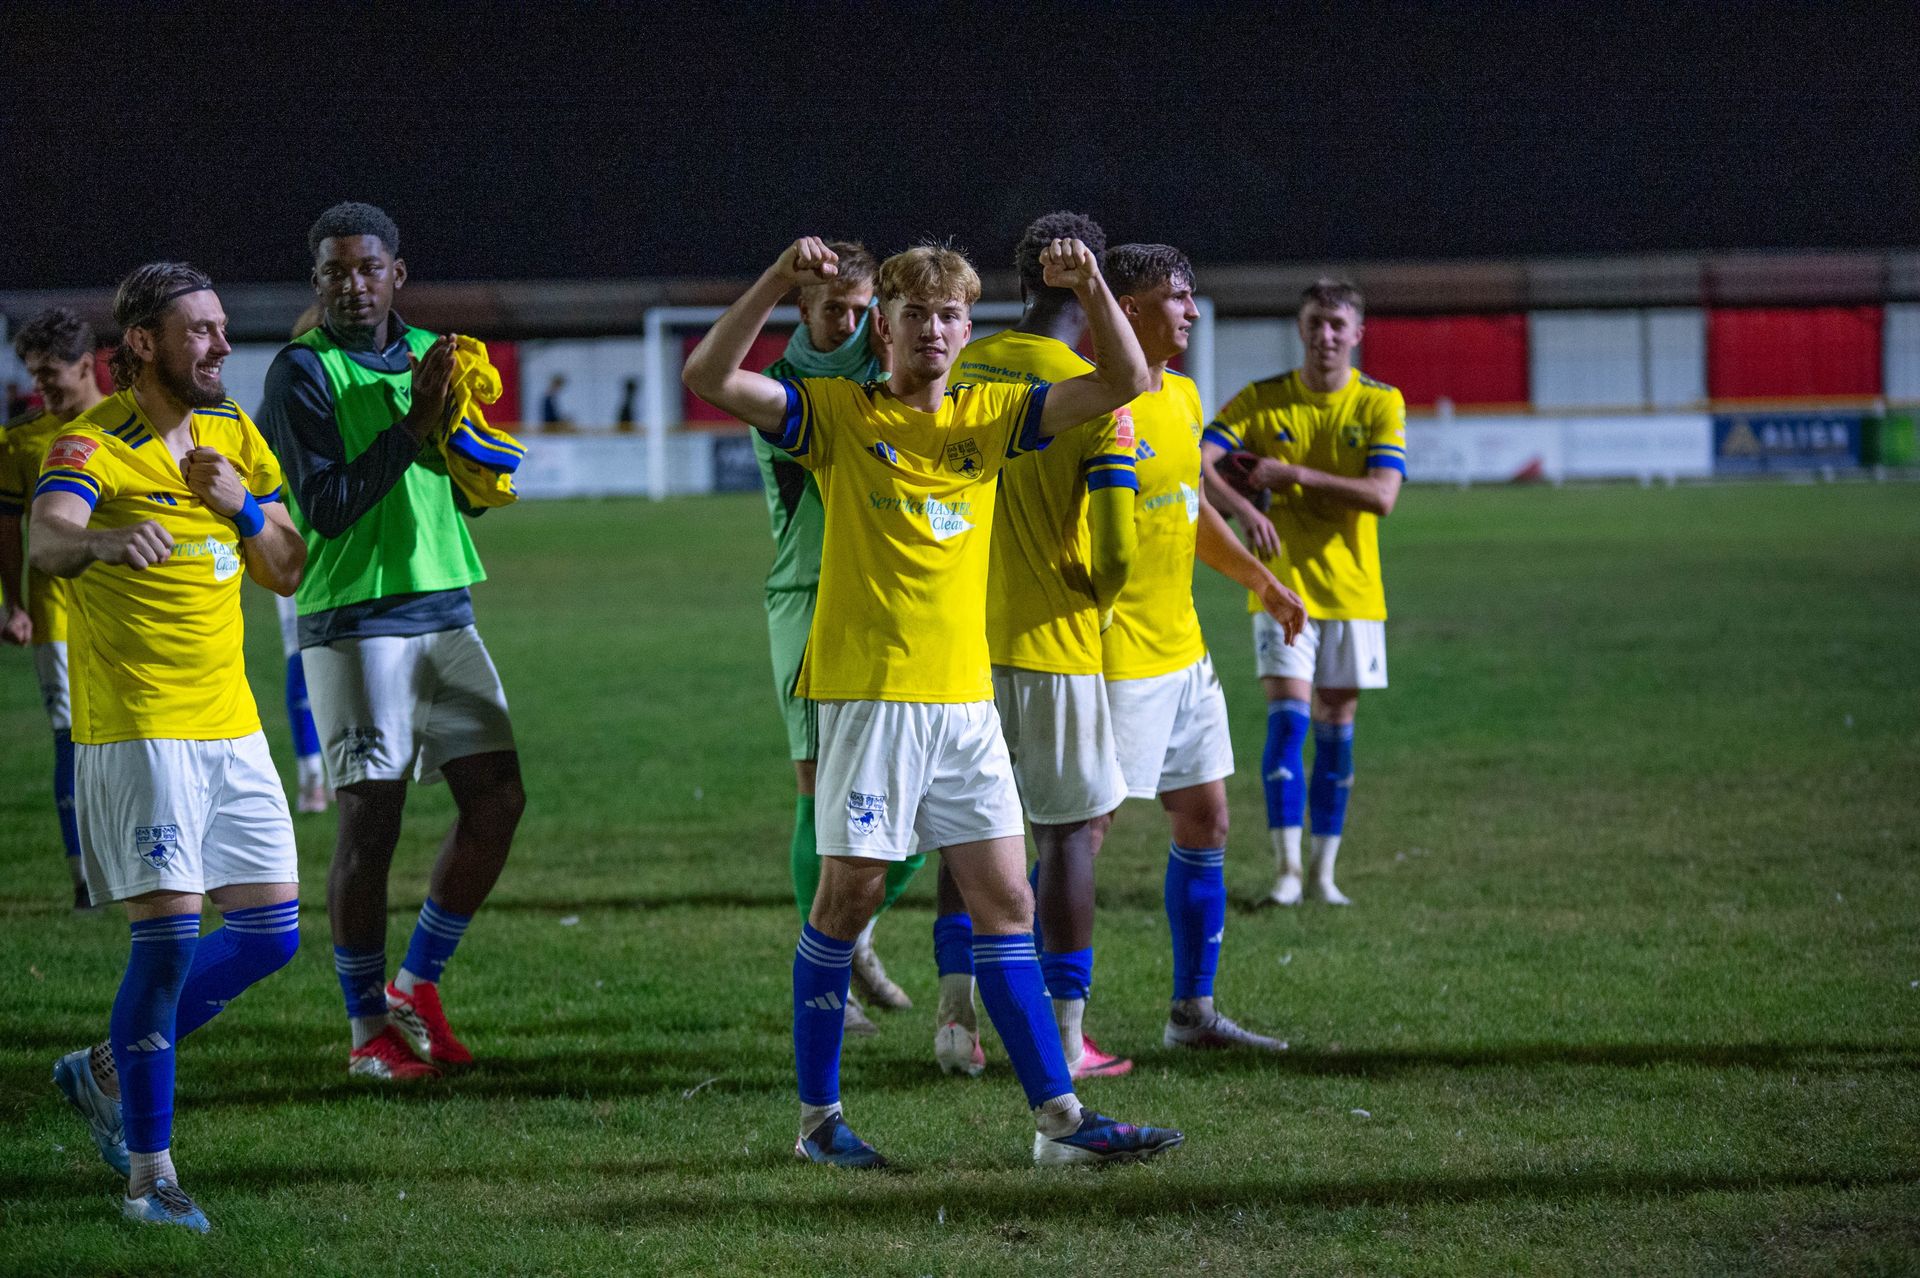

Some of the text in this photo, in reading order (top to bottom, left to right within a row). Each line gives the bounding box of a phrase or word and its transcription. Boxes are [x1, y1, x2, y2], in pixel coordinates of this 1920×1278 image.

[960, 361, 1049, 387] Newmarket Spo
[932, 516, 963, 531] Clean
